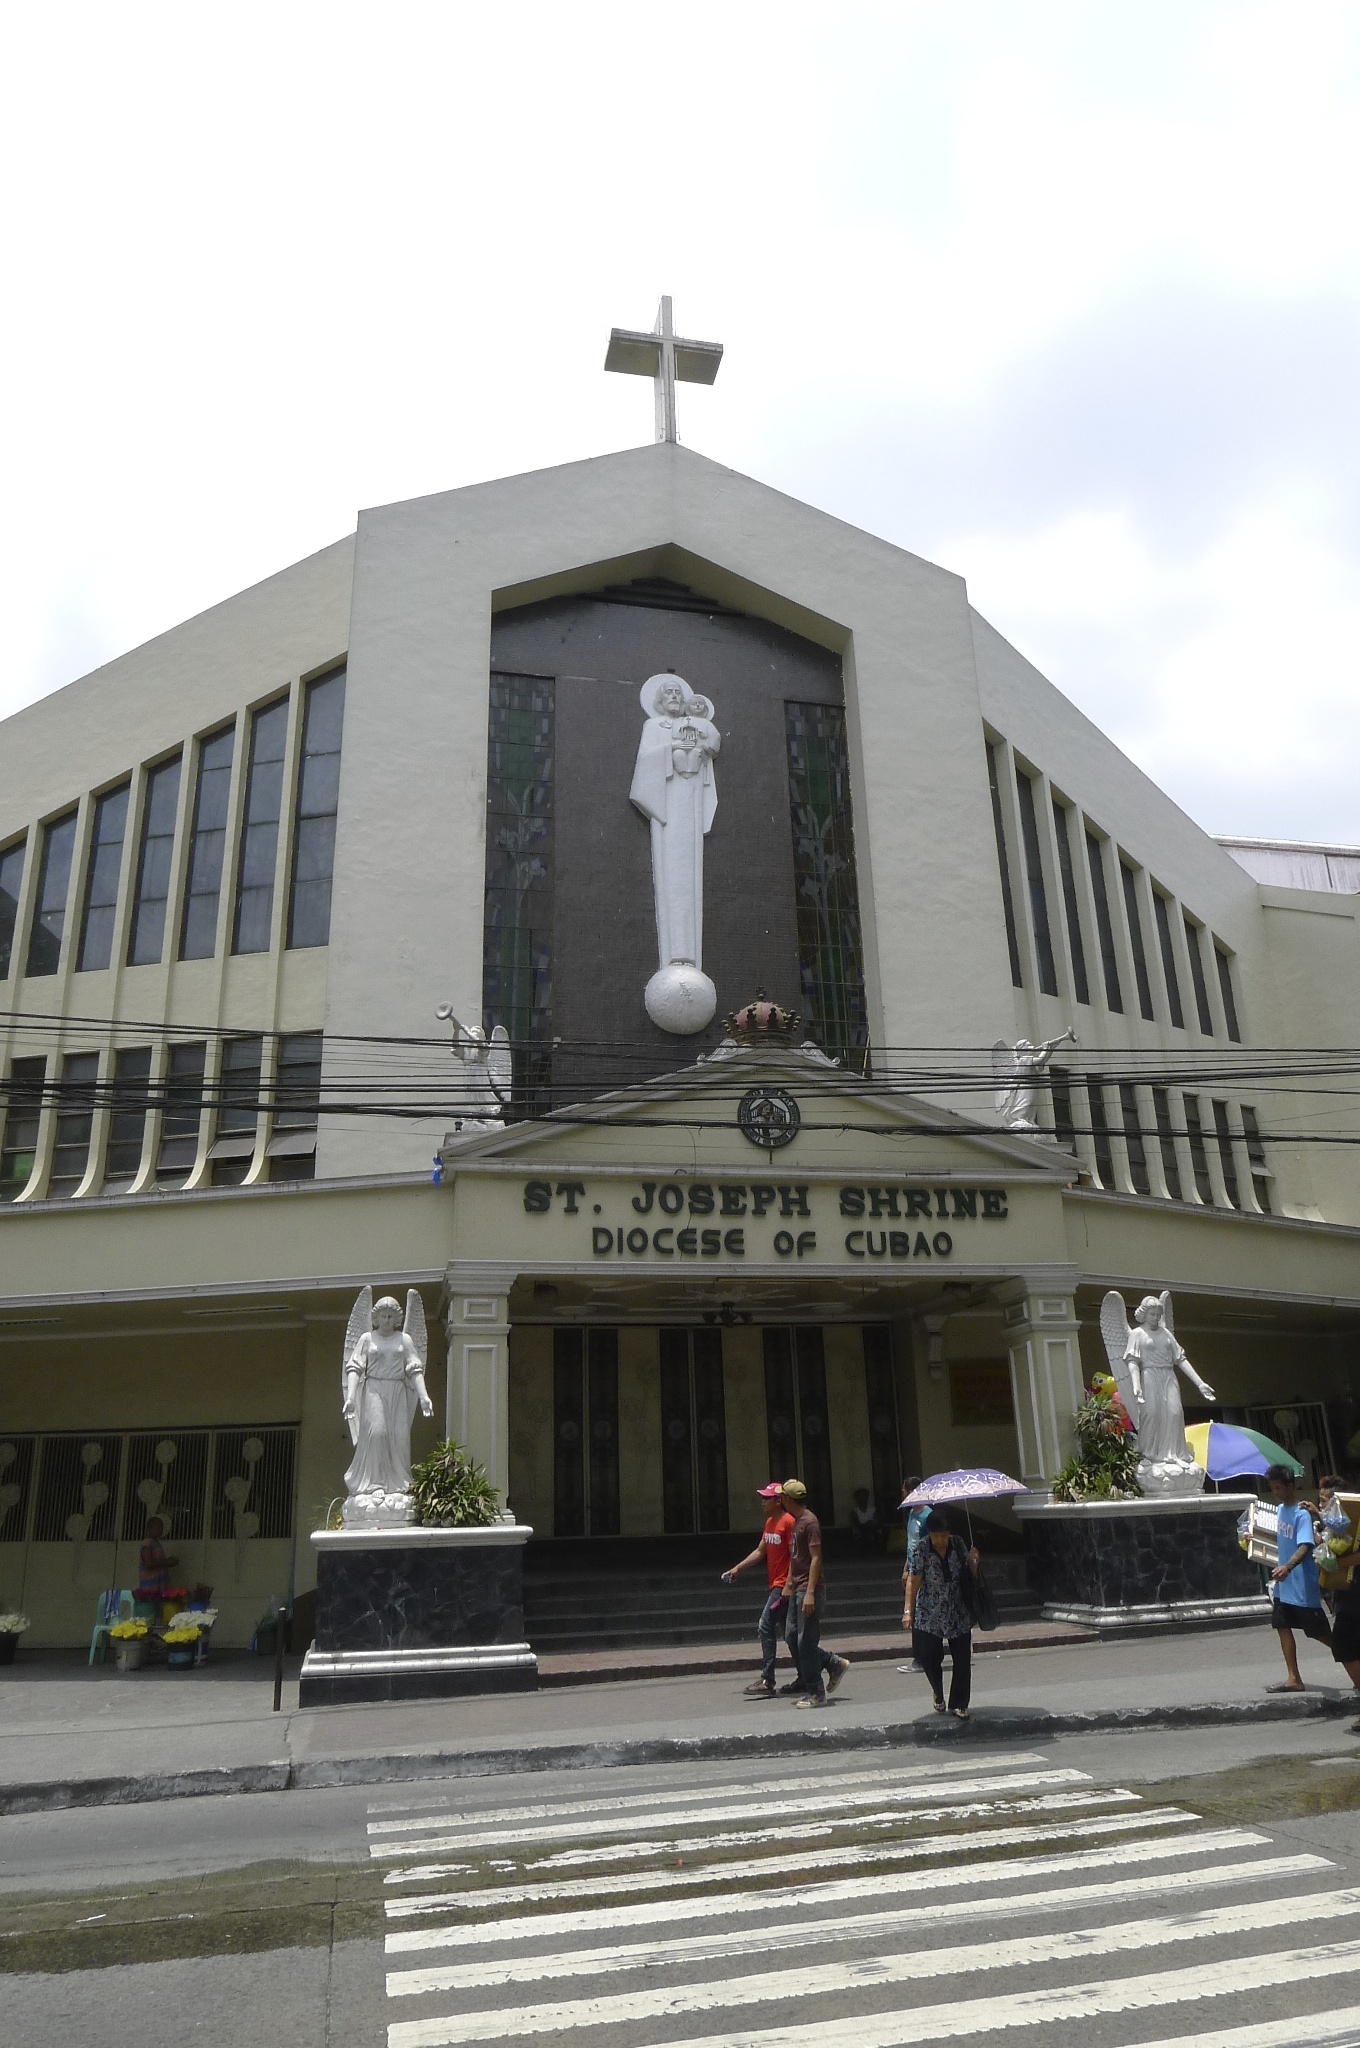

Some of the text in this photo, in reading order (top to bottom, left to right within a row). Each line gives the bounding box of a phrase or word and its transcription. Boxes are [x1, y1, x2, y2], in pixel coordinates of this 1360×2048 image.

[523, 1181, 1009, 1218] ST. JOSEPH SHRINE
[592, 1227, 953, 1257] DIOCESE OF CUBAO
